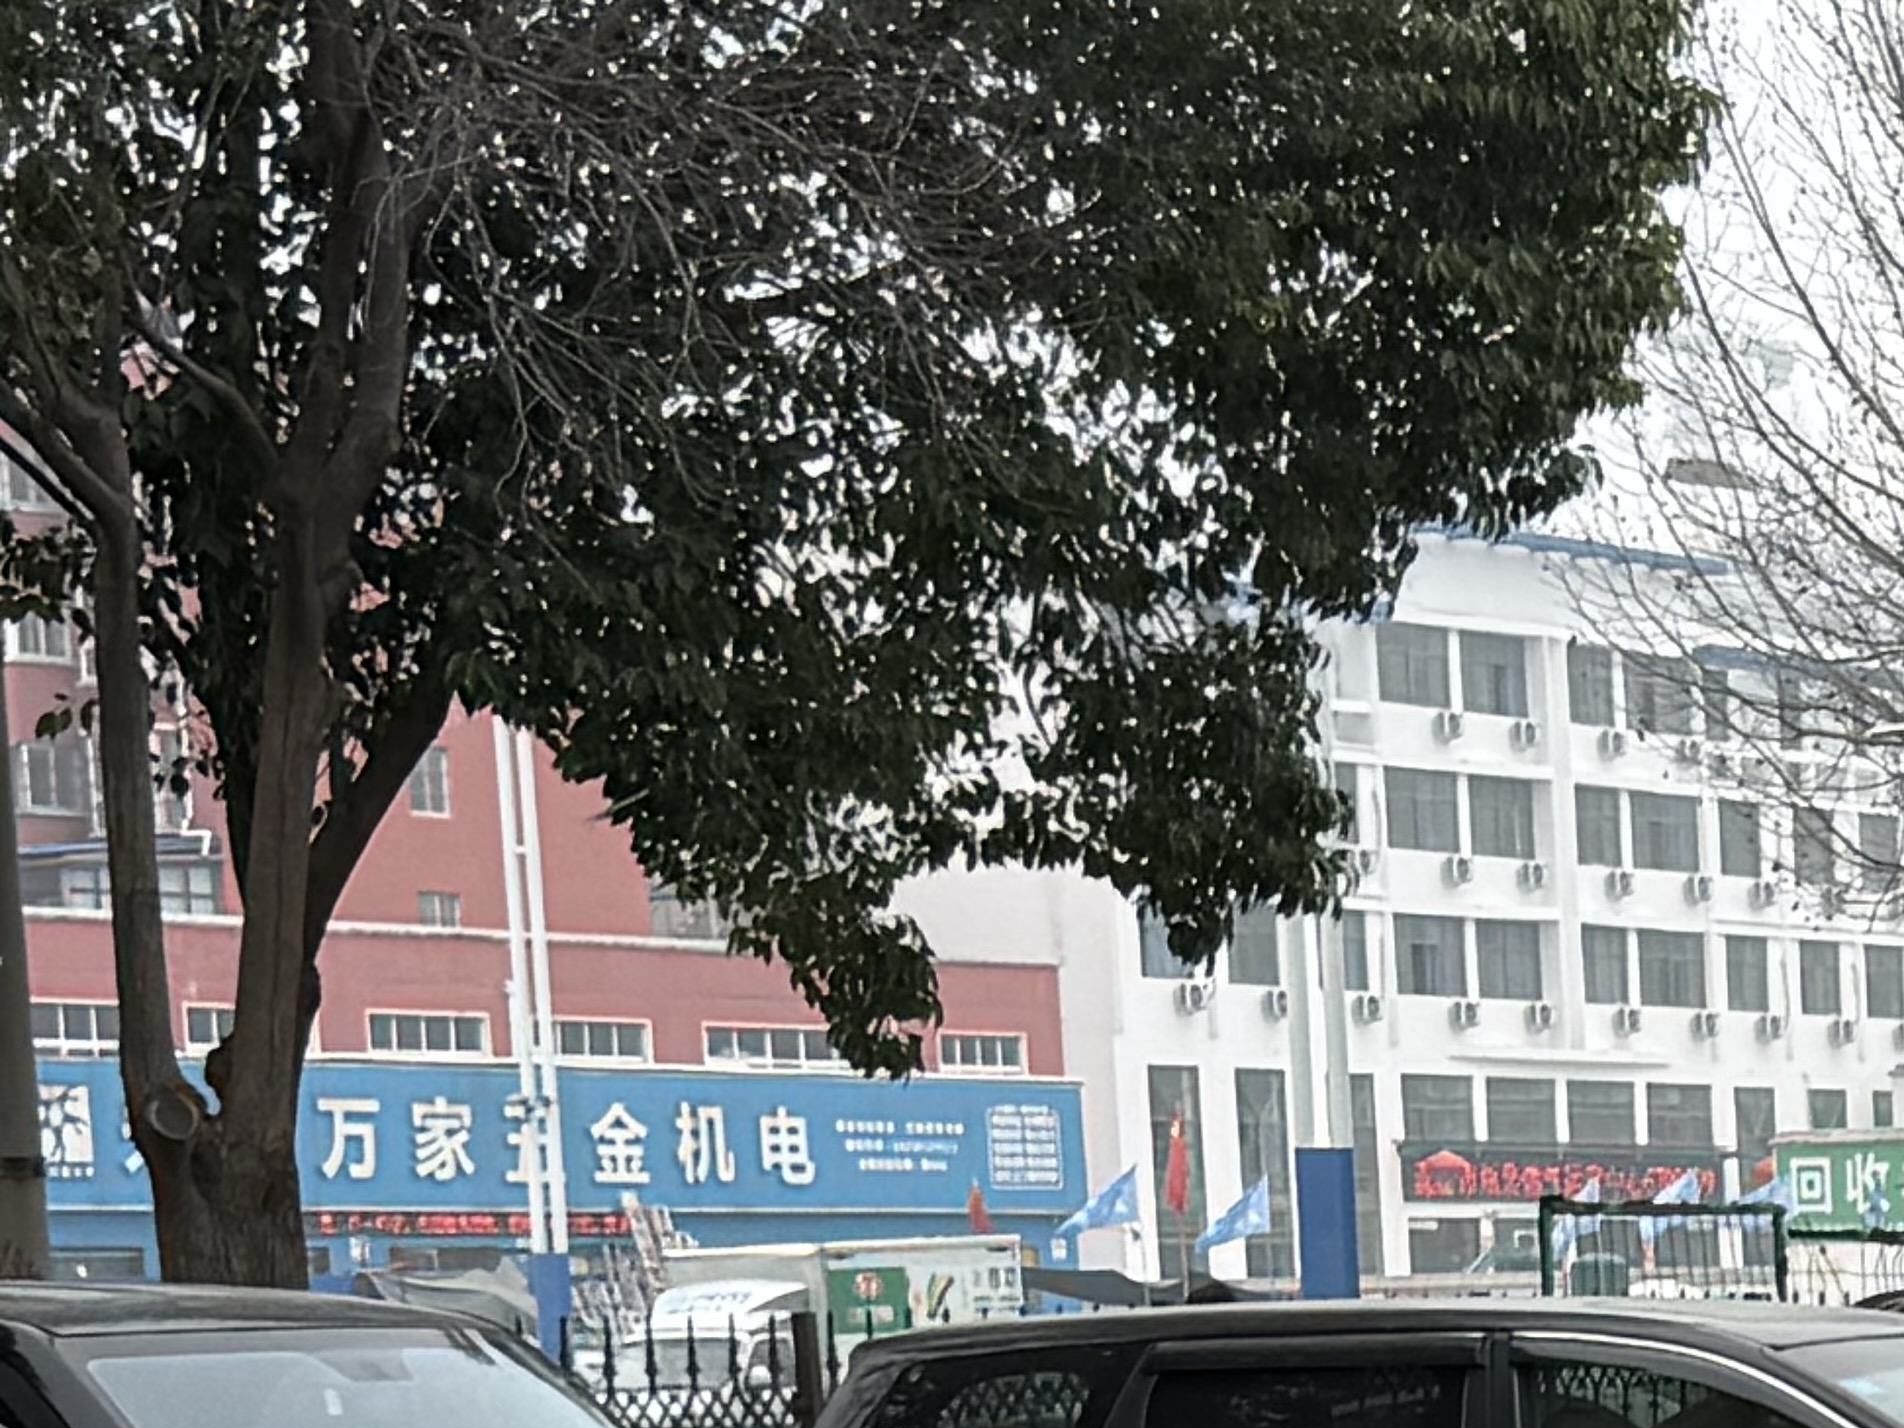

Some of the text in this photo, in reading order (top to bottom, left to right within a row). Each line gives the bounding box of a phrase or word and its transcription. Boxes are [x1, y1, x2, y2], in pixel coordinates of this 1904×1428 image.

[317, 1096, 816, 1186] 万家五金机电
